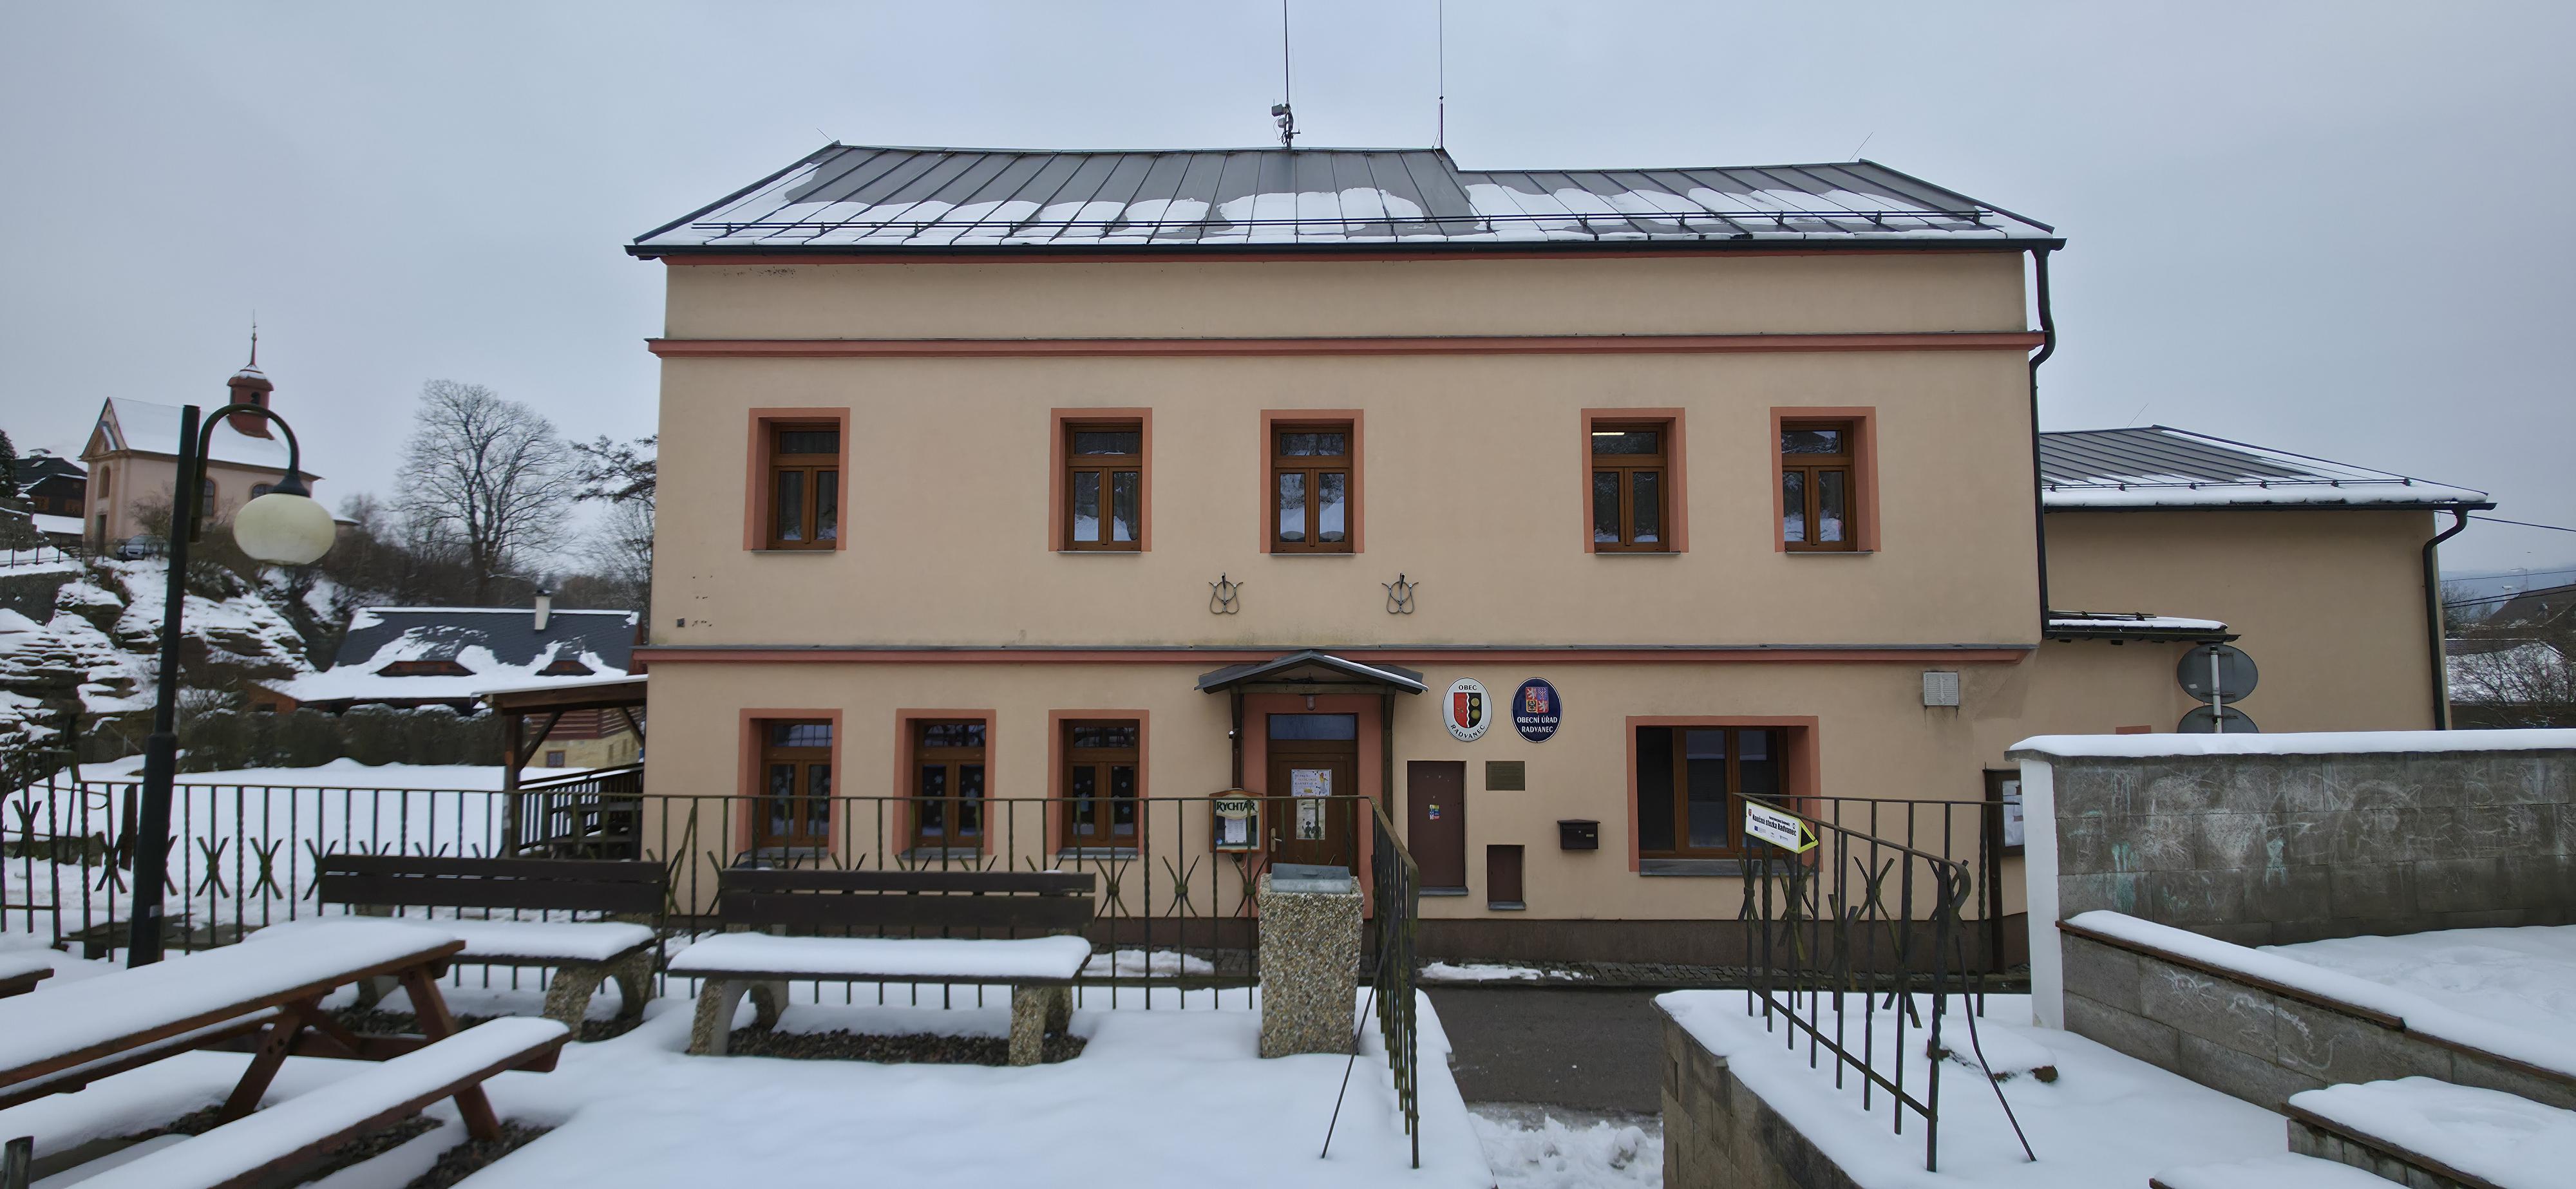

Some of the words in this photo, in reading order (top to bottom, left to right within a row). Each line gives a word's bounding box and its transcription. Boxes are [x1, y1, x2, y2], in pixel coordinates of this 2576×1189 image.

[1517, 715, 1540, 724] OBECNÍ
[1541, 715, 1558, 724] ÚŘAD
[1450, 724, 1486, 739] RADVANEC
[1766, 819, 1777, 830] stezka
[1777, 823, 1797, 836] Radvanec
